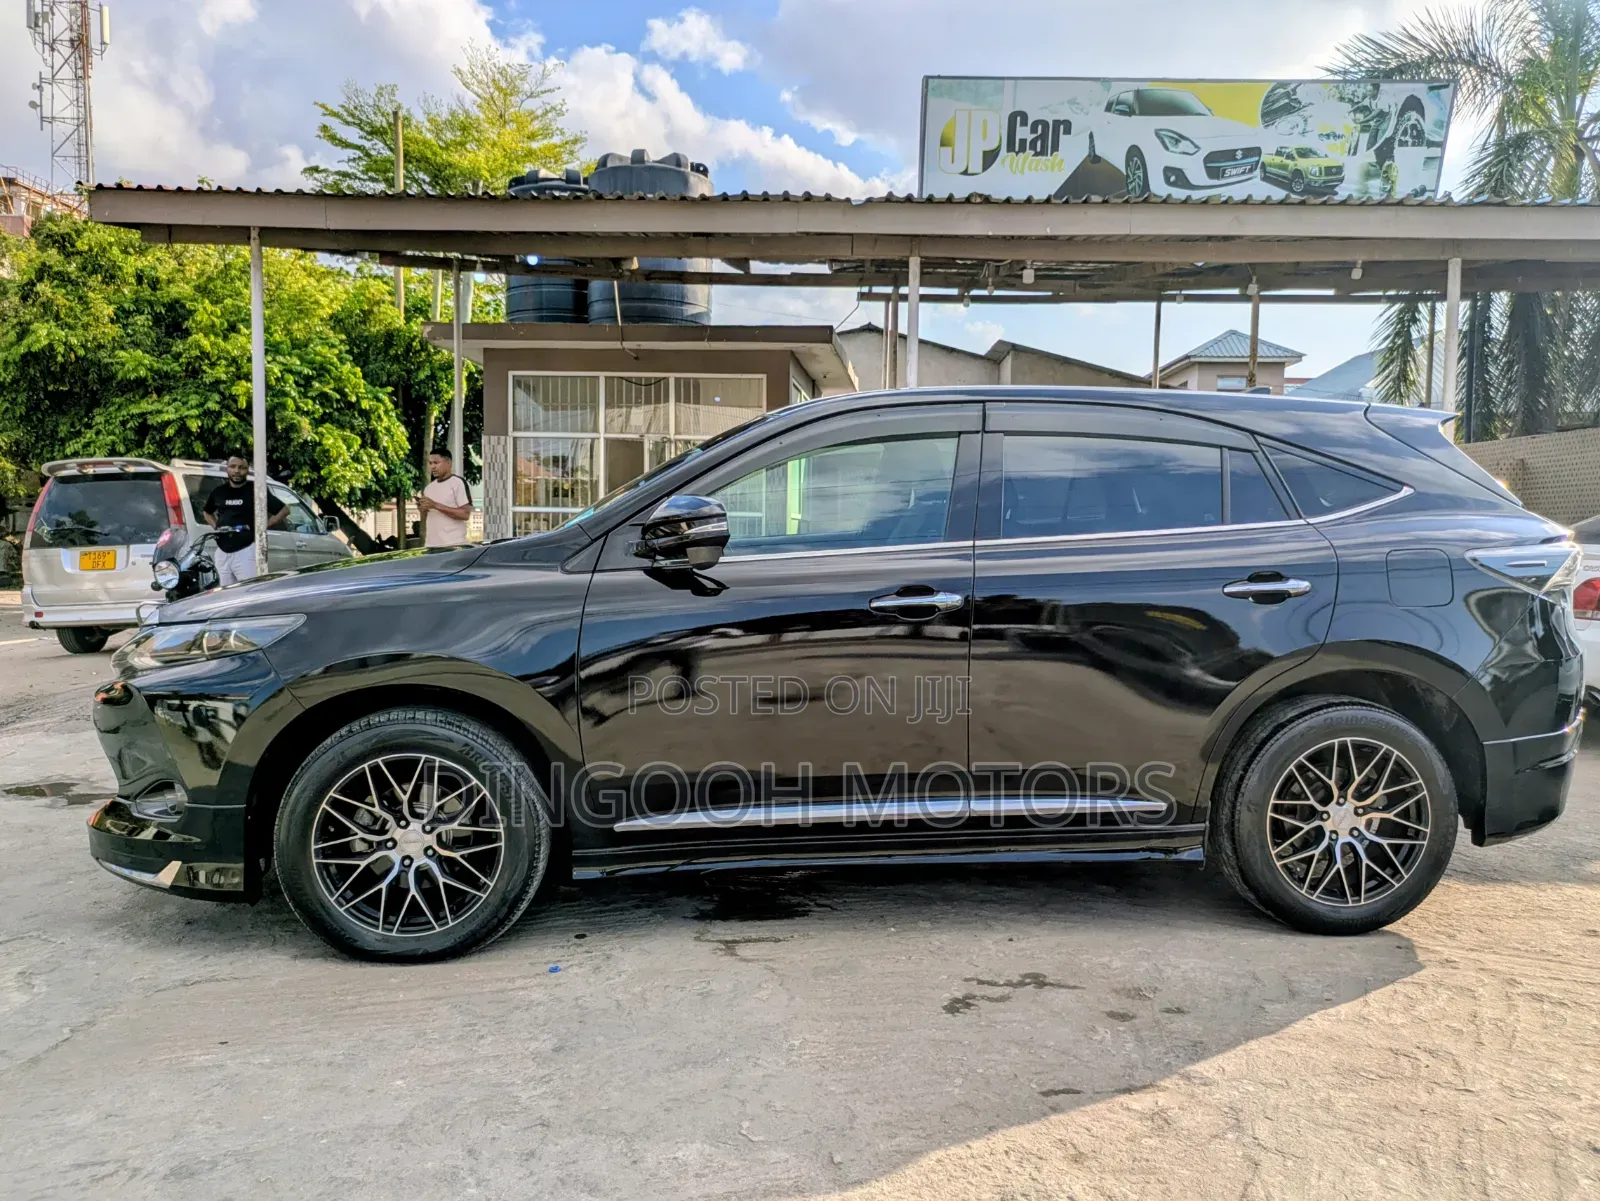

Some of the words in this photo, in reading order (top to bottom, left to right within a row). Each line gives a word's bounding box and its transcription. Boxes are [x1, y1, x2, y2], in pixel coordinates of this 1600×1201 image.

[939, 108, 1001, 174] JP
[1006, 110, 1072, 158] Car
[1001, 151, 1065, 176] Wash
[1224, 165, 1252, 177] SWIFT
[225, 498, 244, 506] HUGO
